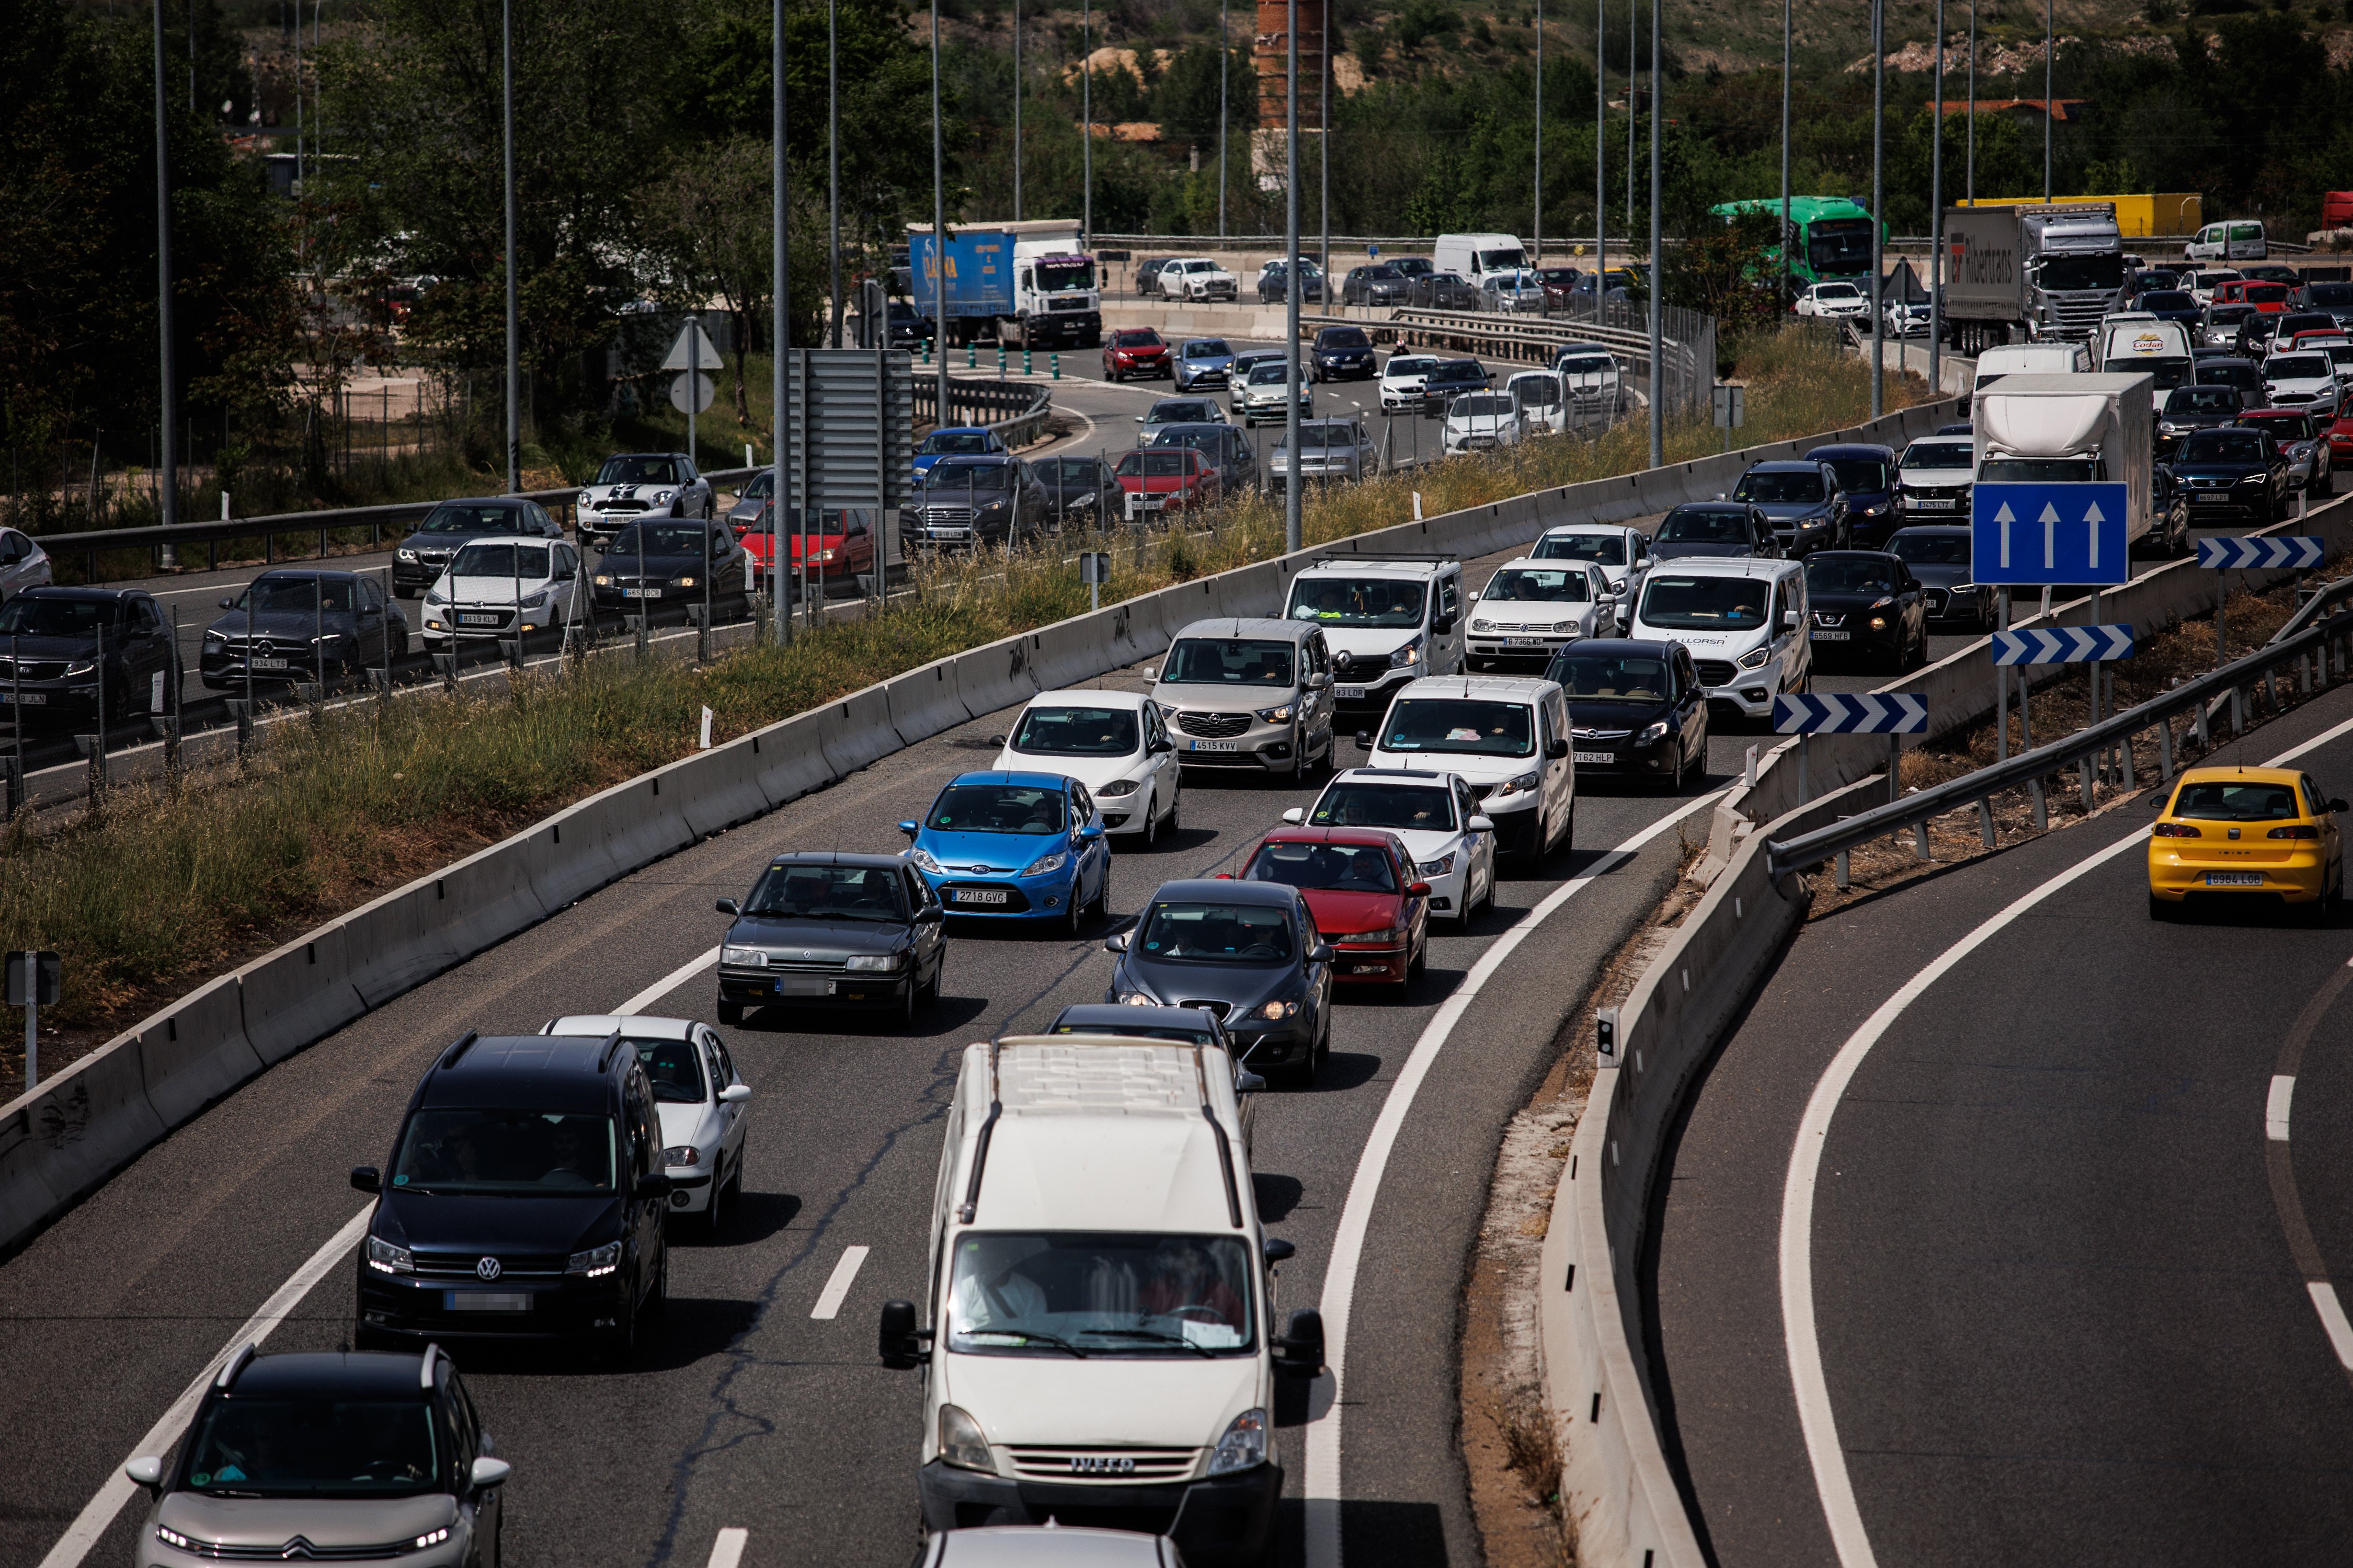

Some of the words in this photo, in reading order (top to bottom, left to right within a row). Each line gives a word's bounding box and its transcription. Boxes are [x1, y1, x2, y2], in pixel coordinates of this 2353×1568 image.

[1966, 235, 2012, 284] Ribertrans
[270, 659, 285, 668] LTS
[5, 694, 25, 703] 258
[28, 695, 45, 703] JLN
[1197, 741, 1217, 750] 4515
[1219, 741, 1236, 750] KVV
[1574, 752, 1594, 762] 7162
[1596, 753, 1612, 762] HLP
[2213, 875, 2238, 884] 6984
[2241, 876, 2260, 885] LGB
[960, 890, 983, 901] 2718
[985, 892, 1003, 902] GVG
[1071, 1458, 1135, 1472] IVECO
